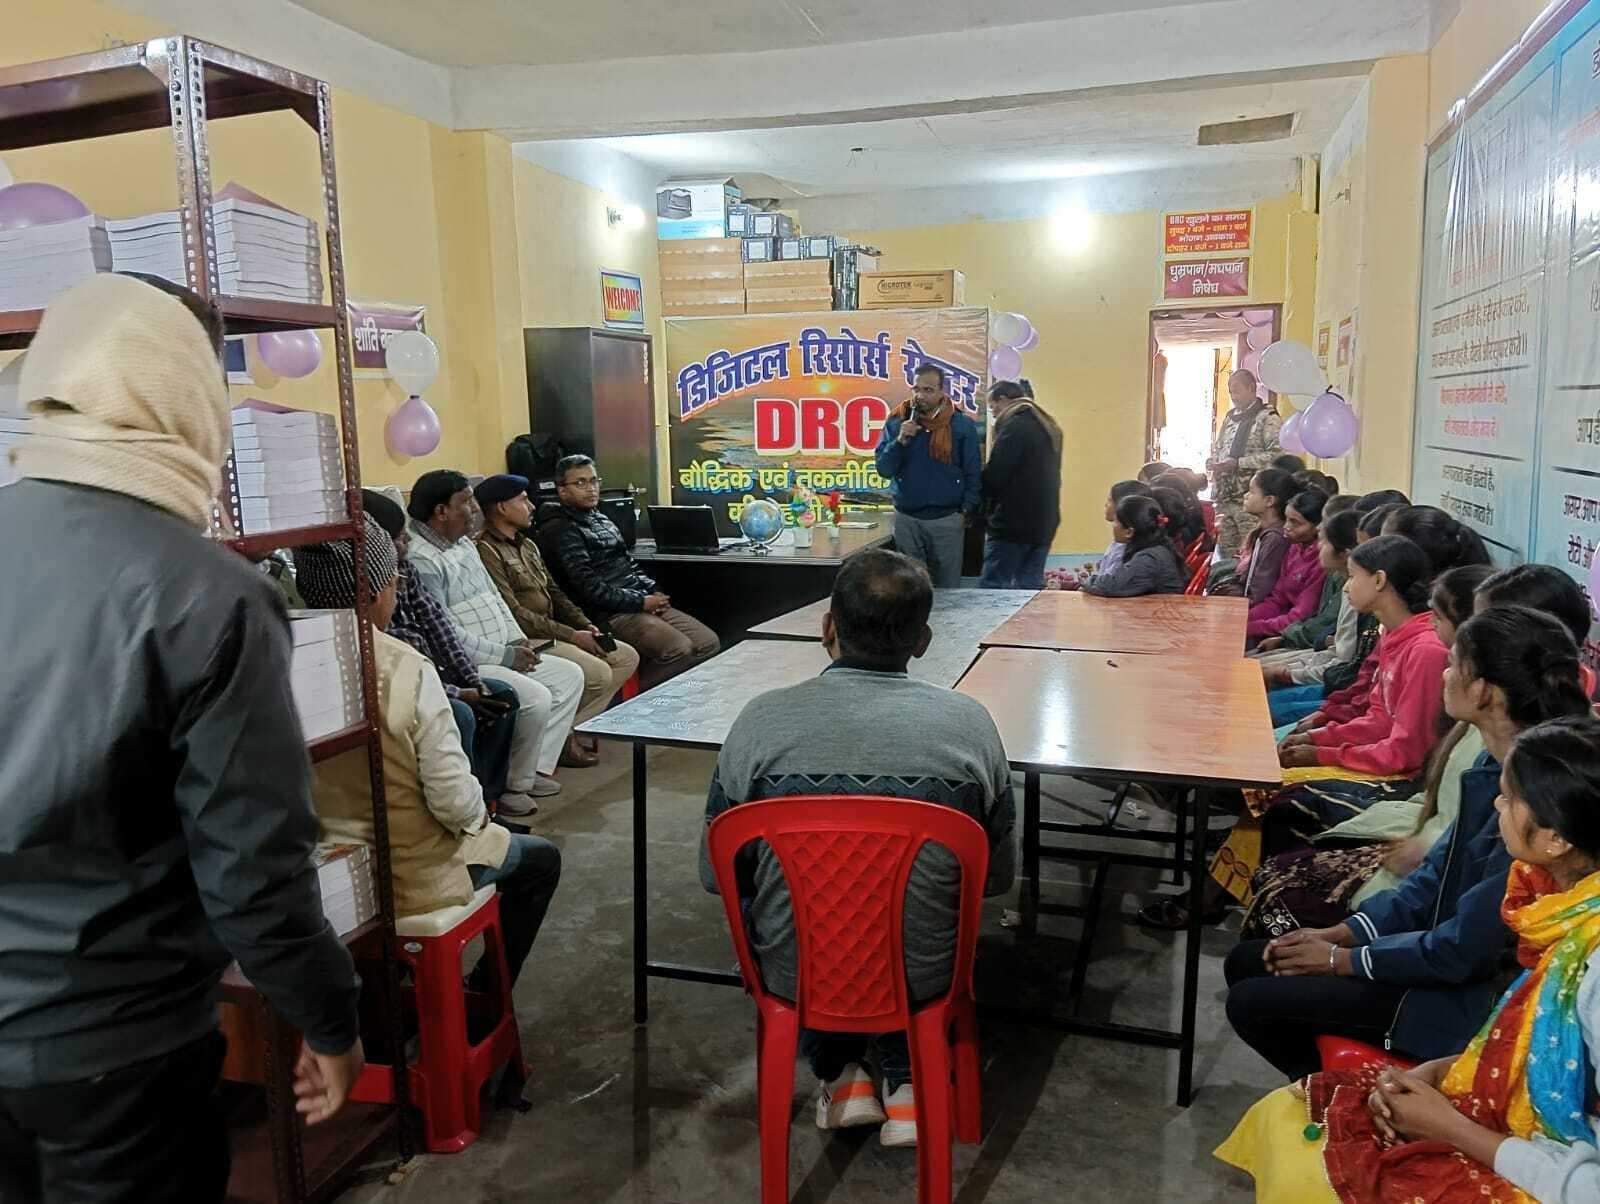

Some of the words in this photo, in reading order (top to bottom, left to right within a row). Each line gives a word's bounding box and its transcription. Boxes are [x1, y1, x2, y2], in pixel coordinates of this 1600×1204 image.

[604, 285, 640, 312] WELCOME
[355, 317, 379, 352] शांति
[678, 339, 790, 421] डिजिटल
[800, 327, 891, 381] रिसोर्स
[754, 396, 890, 456] DRC
[758, 462, 790, 491] एवं
